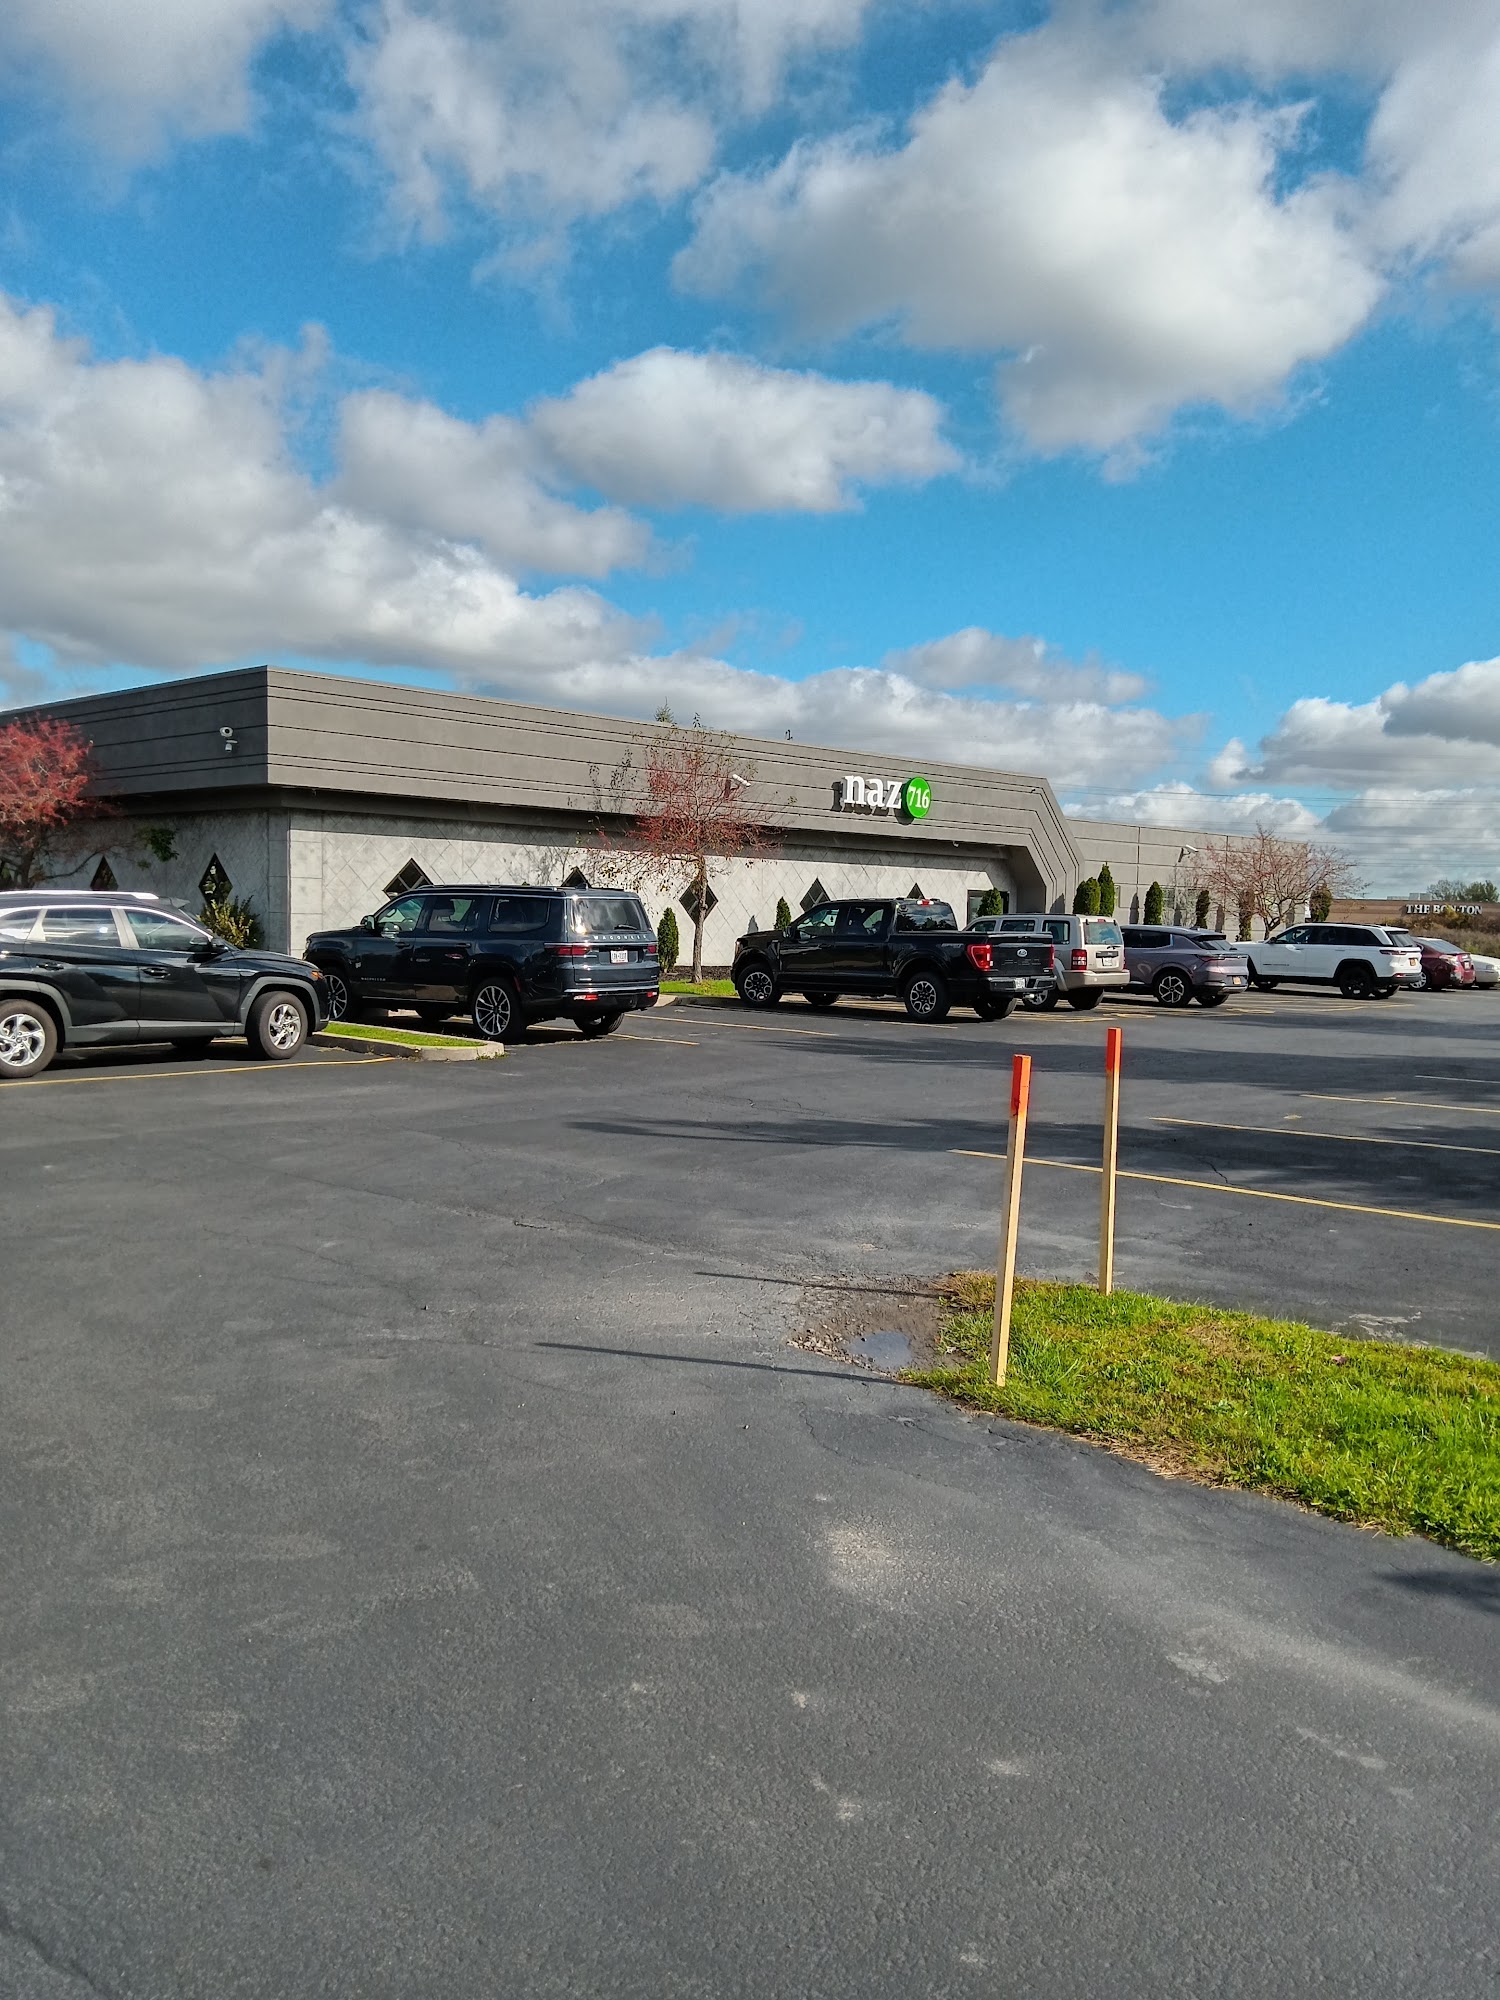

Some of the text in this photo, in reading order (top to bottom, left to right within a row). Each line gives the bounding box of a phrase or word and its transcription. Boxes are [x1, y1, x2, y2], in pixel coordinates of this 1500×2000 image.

[843, 775, 930, 809] naz 716
[1406, 904, 1430, 914] THE
